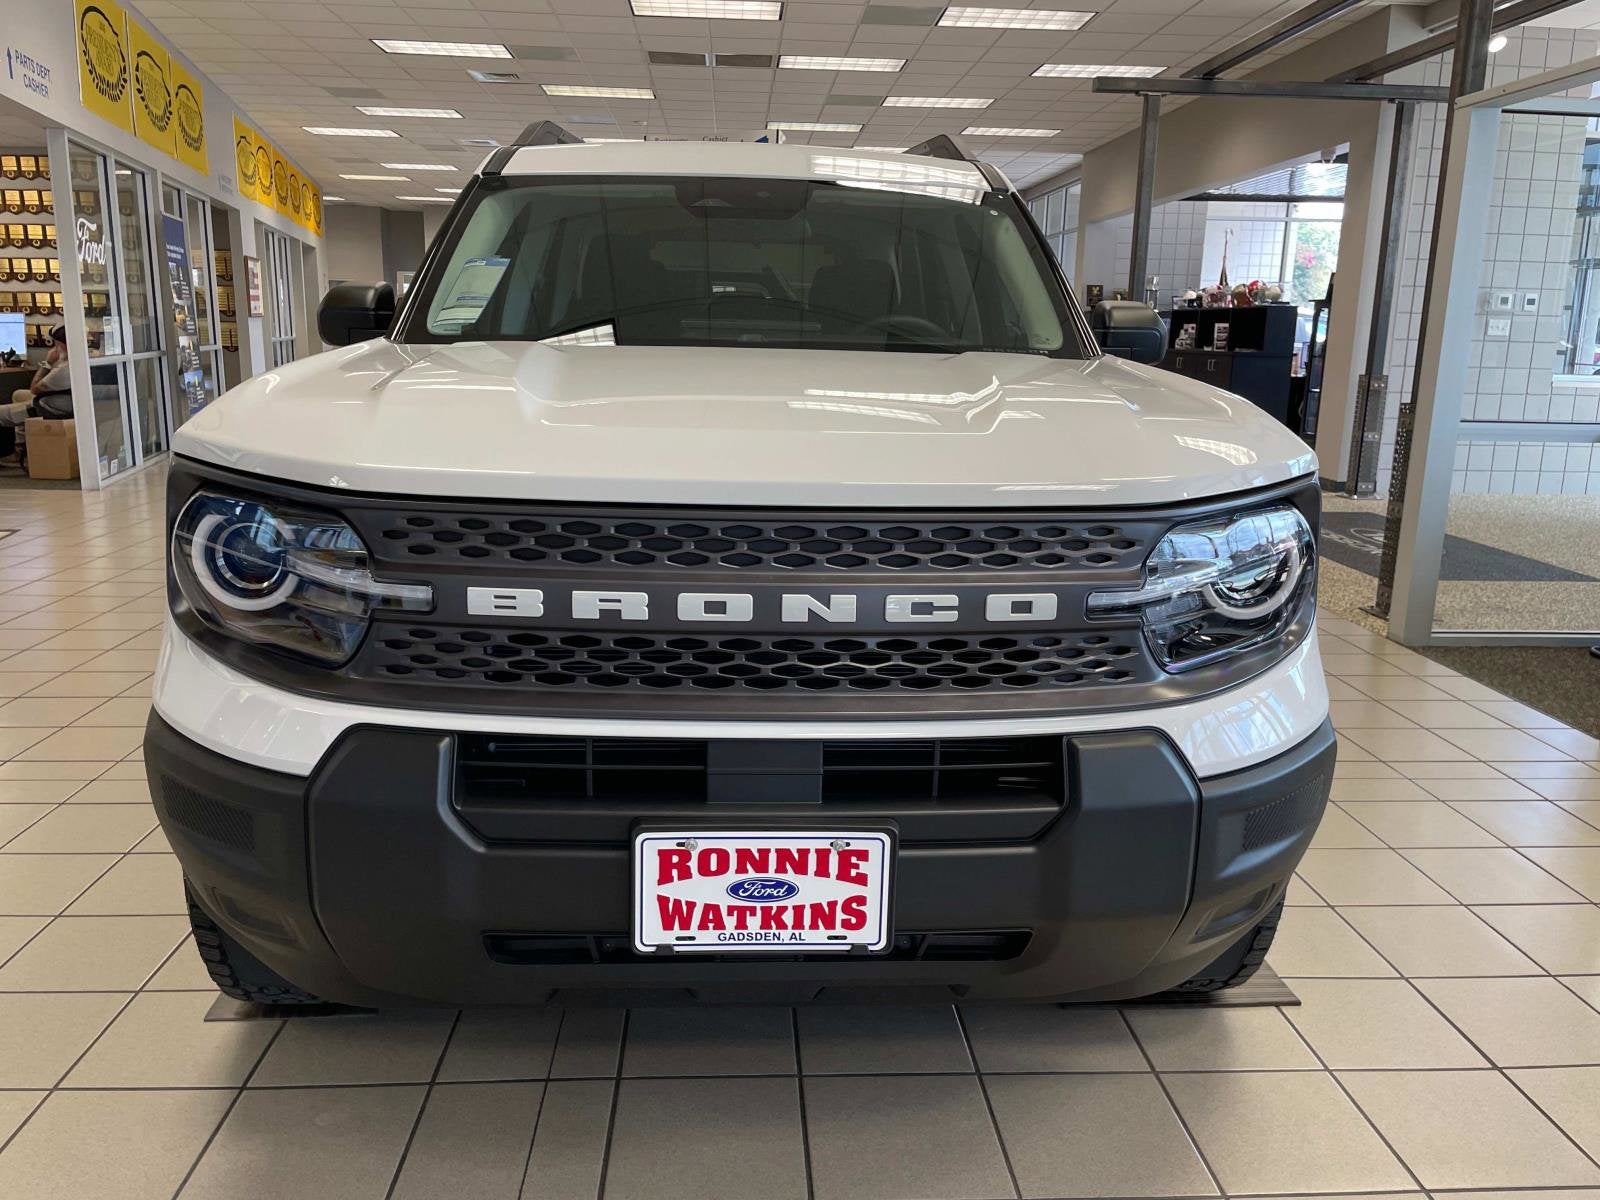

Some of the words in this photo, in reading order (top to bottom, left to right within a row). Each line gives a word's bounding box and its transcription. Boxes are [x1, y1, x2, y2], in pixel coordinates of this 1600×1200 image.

[15, 49, 36, 74] PARTS
[23, 73, 49, 98] CASHIER
[77, 217, 107, 265] Ford
[467, 587, 1058, 623] BRONCO
[656, 848, 870, 887] RONNIE
[738, 880, 788, 897] Ford
[656, 894, 869, 931] WATKINS
[717, 932, 785, 942] GADSDEN,
[789, 932, 806, 942] AL
